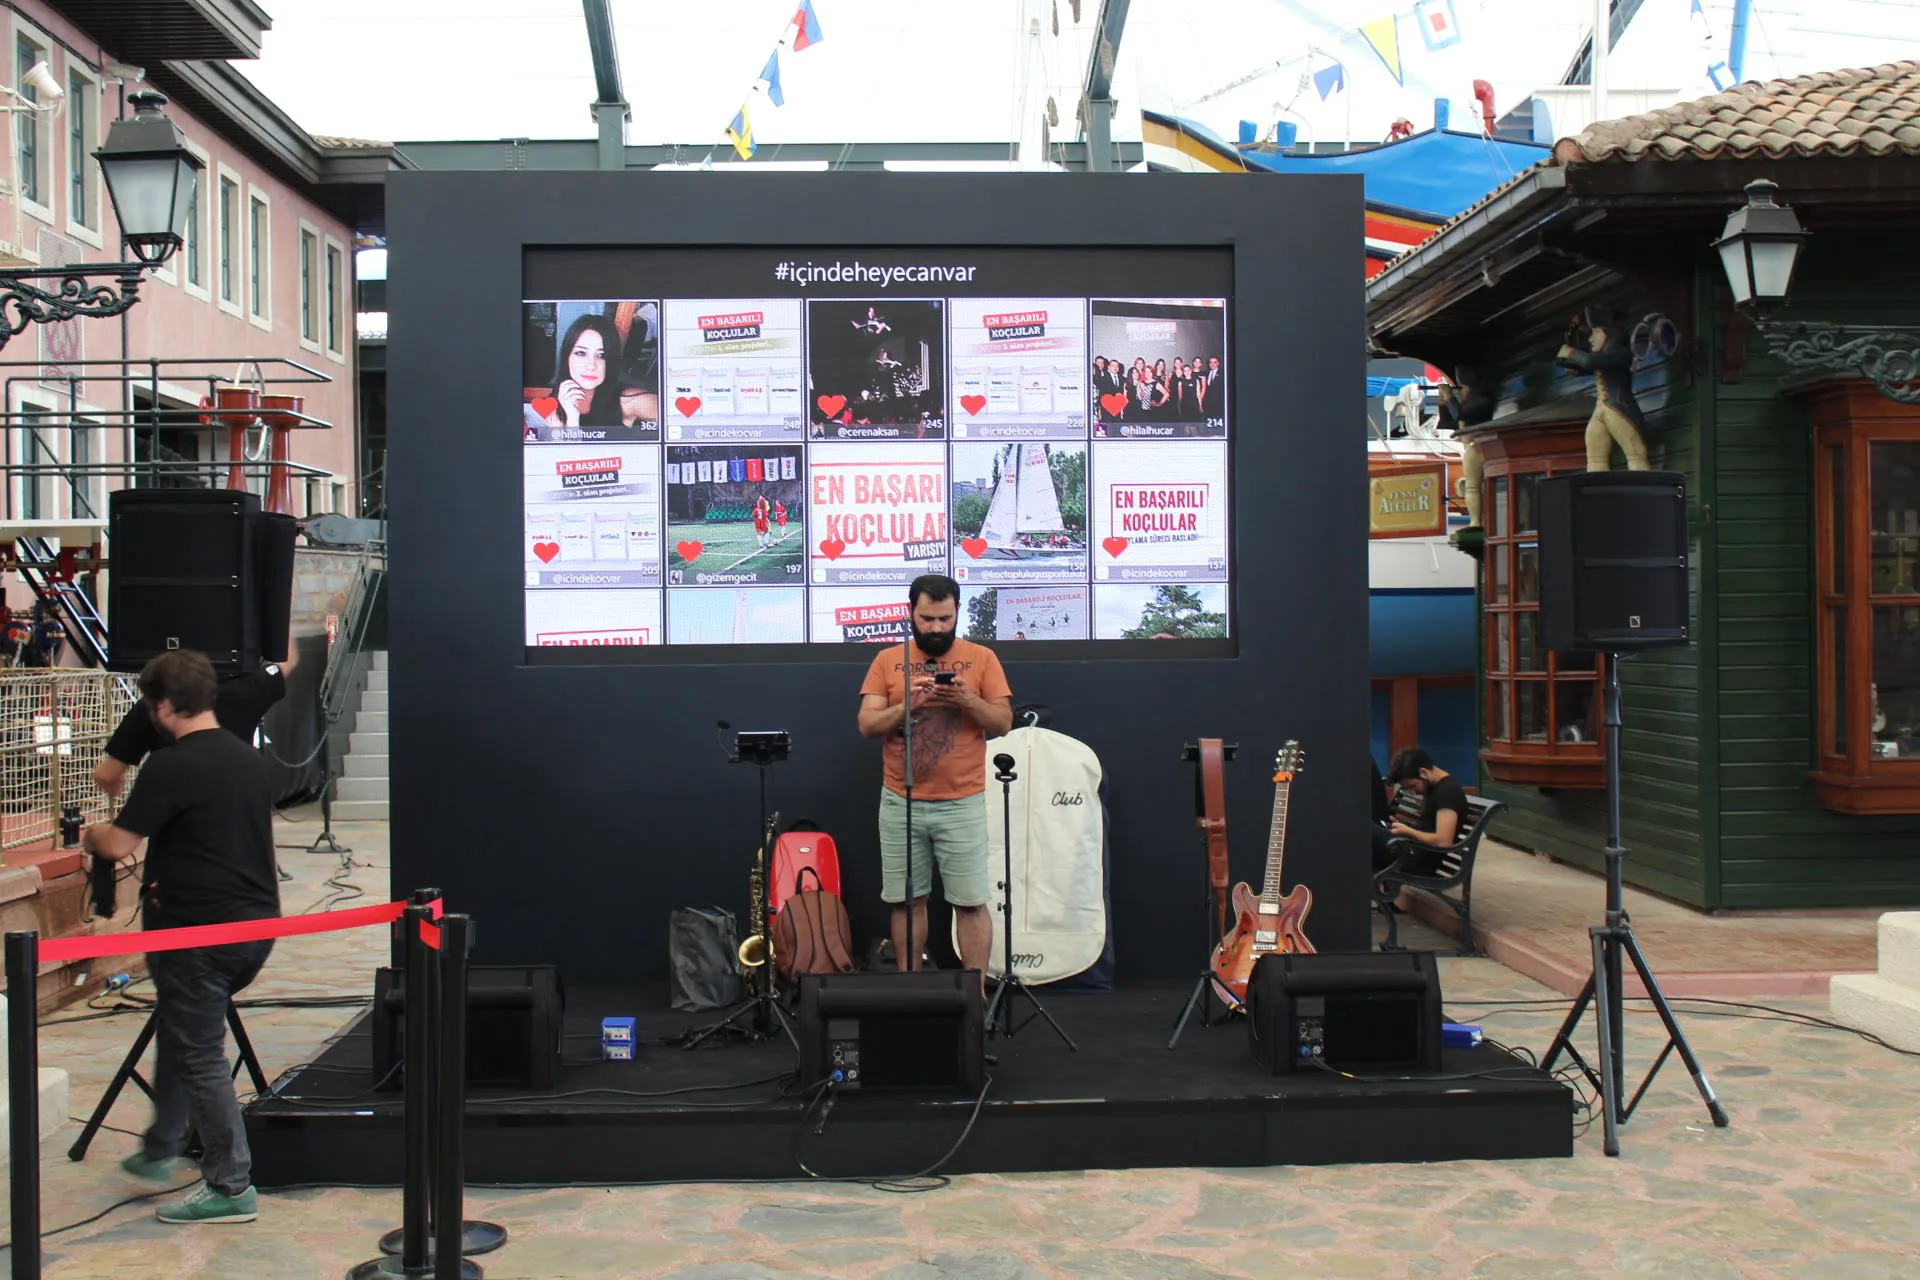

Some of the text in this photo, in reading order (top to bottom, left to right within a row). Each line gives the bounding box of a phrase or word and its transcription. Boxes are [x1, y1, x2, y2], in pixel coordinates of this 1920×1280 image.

[774, 261, 976, 287] #içindeheyecanvar
[701, 314, 761, 327] EN BAŞARILI
[986, 313, 1045, 326] EN BAŞARILI
[707, 327, 757, 340] KOÇLULAR
[991, 326, 1041, 339] KOÇLULAR
[641, 421, 657, 431] 362
[1206, 418, 1223, 428] 214
[694, 428, 762, 438] @icindekocvar
[837, 427, 899, 437] @cerenaksan
[980, 426, 1046, 436] @icindekocvar
[560, 459, 619, 473] EN BAŞARILI
[565, 472, 615, 485] KOÇLULAR
[813, 474, 845, 505] EN
[1115, 490, 1204, 511] EN BAŞARILI
[1123, 513, 1197, 533] KOÇLULAR
[641, 564, 658, 575] 205
[785, 564, 802, 574] 197
[1121, 568, 1188, 579] @icindekocvar
[552, 574, 621, 584] @icindekocvar
[696, 573, 757, 584] @gizemgecit
[840, 571, 907, 581] @icindekocvar
[840, 610, 857, 623] EN
[951, 660, 973, 672] OF
[1051, 791, 1083, 807] Club
[1011, 953, 1043, 969] Club
